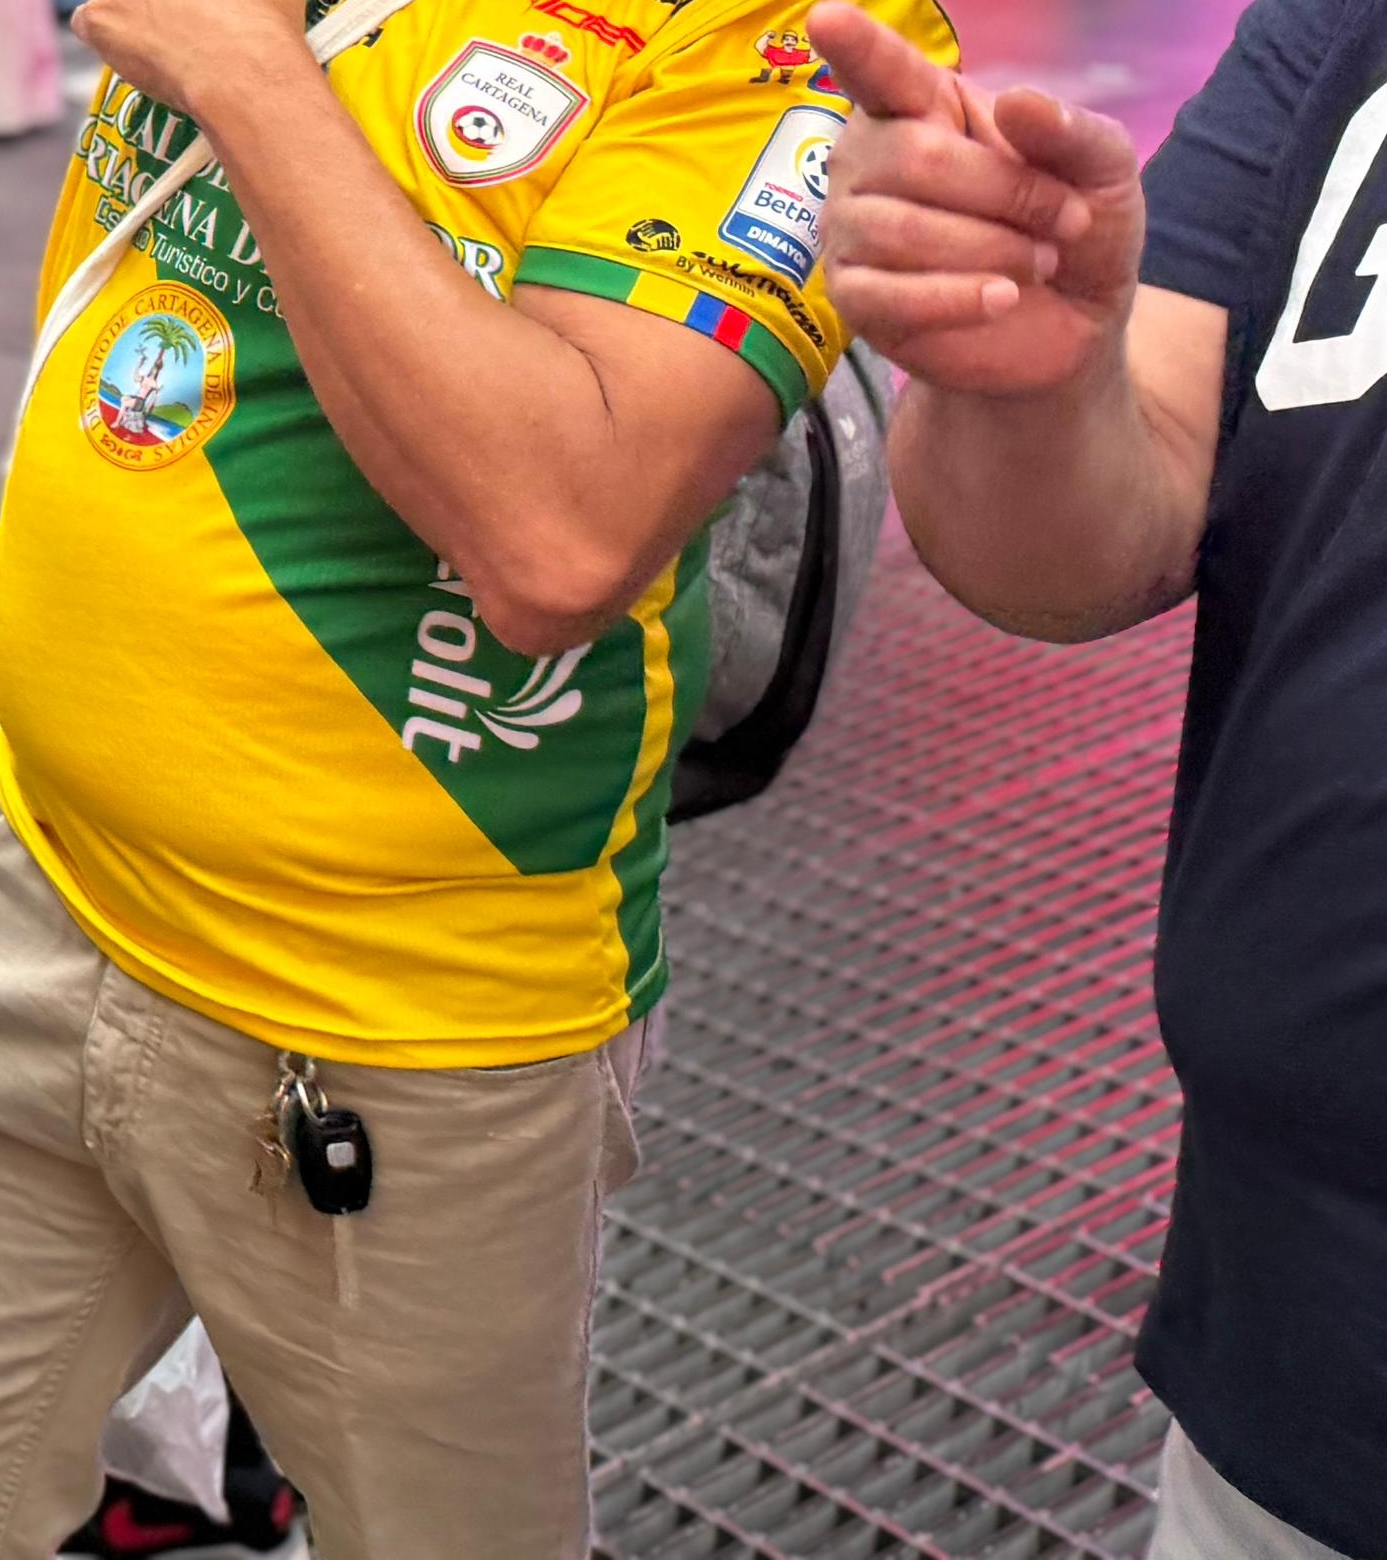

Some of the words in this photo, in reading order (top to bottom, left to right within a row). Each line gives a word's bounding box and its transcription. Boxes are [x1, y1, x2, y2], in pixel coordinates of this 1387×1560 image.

[460, 72, 549, 127] CARTAGENA
[495, 71, 535, 100] REAL
[676, 255, 694, 273] By
[133, 293, 222, 363] CARTAGENA
